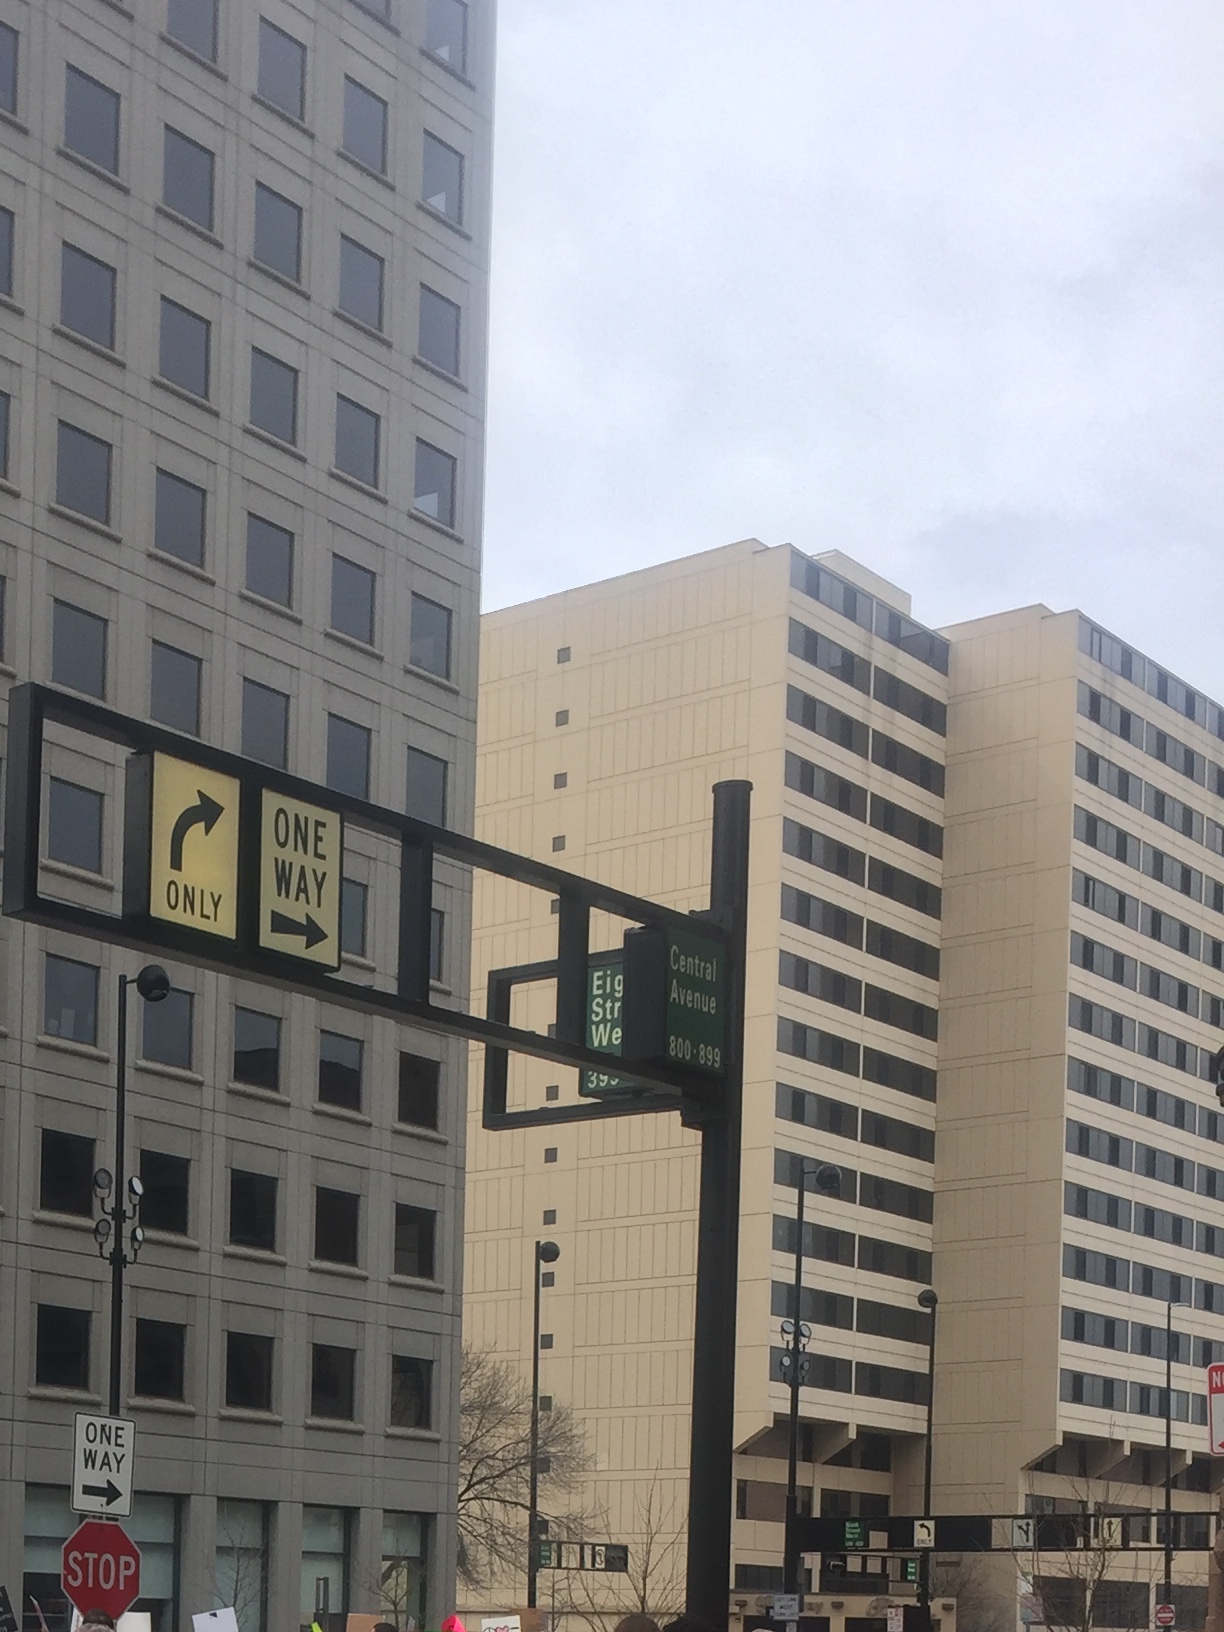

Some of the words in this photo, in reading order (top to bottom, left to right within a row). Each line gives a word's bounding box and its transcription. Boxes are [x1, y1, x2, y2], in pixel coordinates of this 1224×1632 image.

[274, 807, 327, 861] ONE
[273, 856, 327, 909] WAY
[166, 879, 223, 923] ONLY
[669, 944, 717, 983] Central
[591, 970, 624, 998] Eig
[669, 978, 717, 1016] Avenue
[591, 997, 622, 1022] Str
[591, 1022, 623, 1048] We
[1212, 1370, 1224, 1388] N
[85, 1421, 125, 1448] ONE
[83, 1448, 125, 1474] WAY
[67, 1550, 136, 1591] STOP
